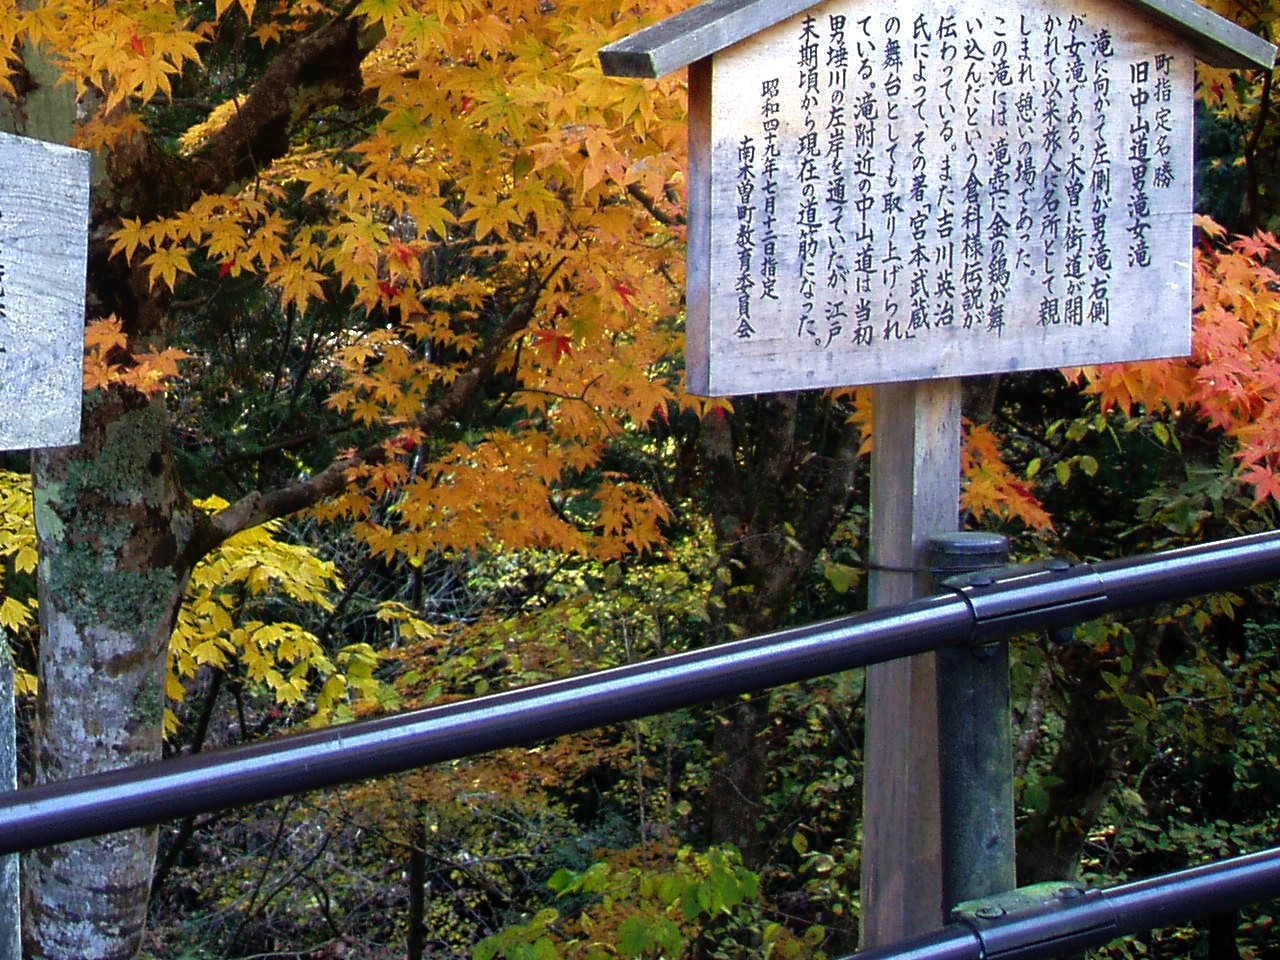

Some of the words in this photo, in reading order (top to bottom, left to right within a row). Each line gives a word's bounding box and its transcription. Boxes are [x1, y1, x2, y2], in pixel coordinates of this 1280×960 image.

[734, 134, 757, 339] 南木曽町教育委員会
[759, 77, 781, 301] 昭和四十九年七月十二日指定
[796, 14, 823, 347] 末期頃から現在の道筋になった。
[851, 15, 880, 347] ている。滝附近の中山道は当初
[881, 15, 905, 341] の舞台としても取り上げられ
[905, 12, 932, 340] 氏によって、その著「宮本武蔵」
[933, 15, 958, 328] 伝わっている。また吉川英治
[960, 16, 986, 330] い込んだという倉科様伝説が
[1015, 14, 1037, 277] しまれ、憩いの場であった。
[1037, 14, 1064, 327] かれて以来旅人に名所として親
[1063, 13, 1088, 327] が女滝である。木曽に街道が開
[1087, 28, 1115, 327] 滝に向かって左側が男滝、右側
[1126, 61, 1152, 269] 旧中山道男滝女滝
[1152, 53, 1175, 189] 町指定名勝
